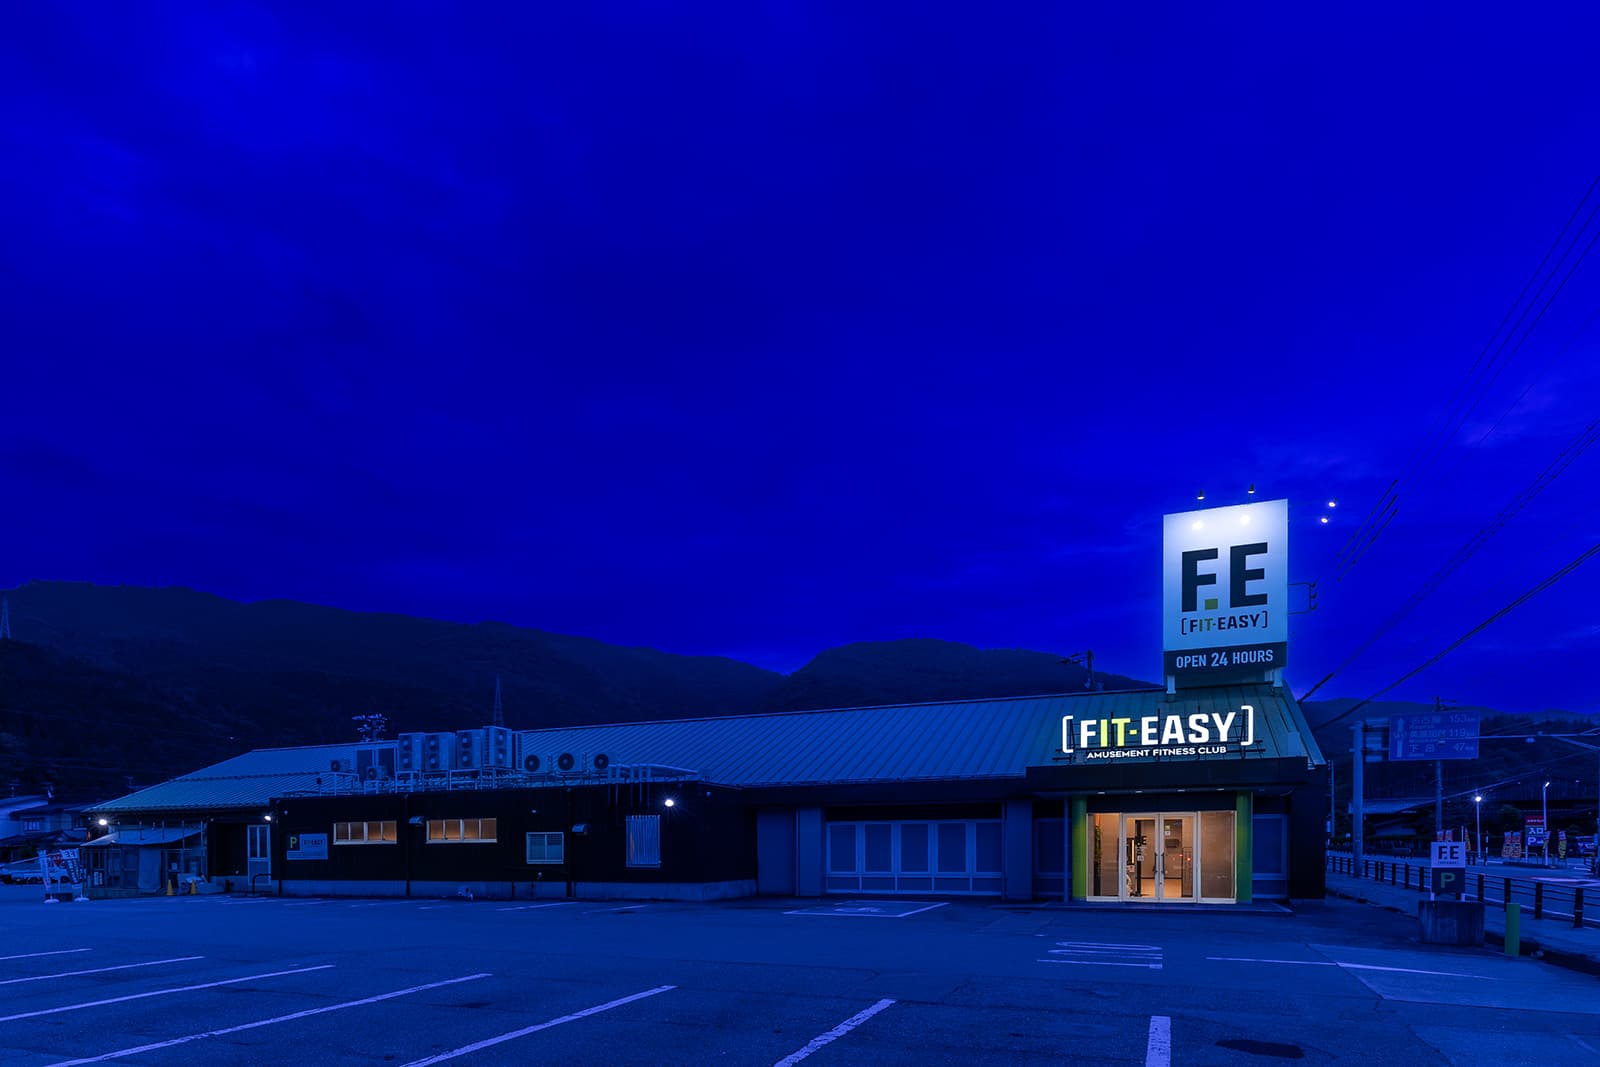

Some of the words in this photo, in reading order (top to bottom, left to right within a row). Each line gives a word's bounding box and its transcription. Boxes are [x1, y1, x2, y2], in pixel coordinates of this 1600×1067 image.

[1176, 654, 1207, 669] OPEN
[1210, 652, 1229, 667] 24
[1232, 649, 1274, 664] HOURS
[1087, 749, 1150, 759] AMUSEMENT
[1153, 747, 1196, 756] FITNESS
[1199, 746, 1227, 755] CLUB
[290, 836, 297, 848] P
[1441, 873, 1455, 888] P
